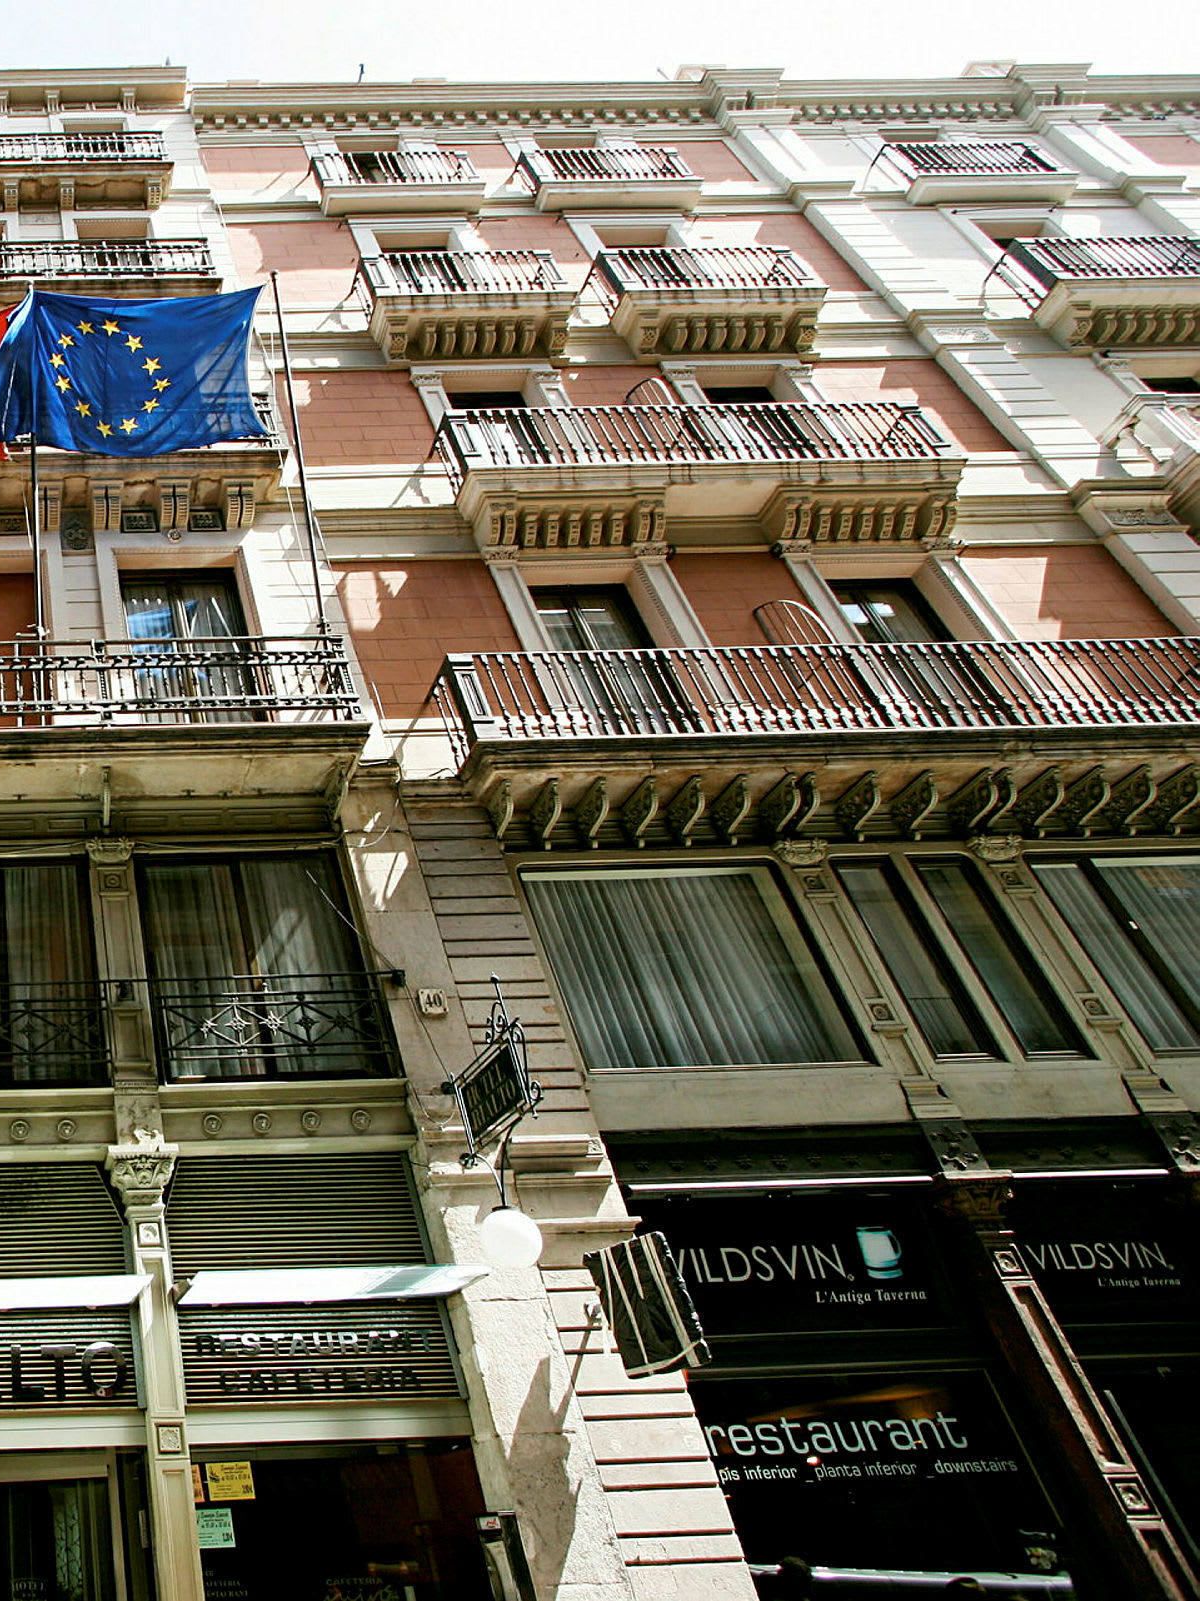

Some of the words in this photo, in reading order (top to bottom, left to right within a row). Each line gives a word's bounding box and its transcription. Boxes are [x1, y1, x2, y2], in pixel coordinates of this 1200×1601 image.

[425, 993, 443, 1008] 40
[471, 1079, 518, 1130] RIALTO
[1142, 1275, 1181, 1286] Taverna
[815, 1289, 872, 1305] L'Antiga
[875, 1287, 927, 1301] Taverna
[195, 1330, 433, 1357] RESTAURANT
[220, 1366, 422, 1393] CAFETERIA
[703, 1411, 969, 1457] restaurant
[717, 1465, 740, 1485] pis
[743, 1463, 798, 1481] inferior
[865, 1460, 917, 1476] inferior
